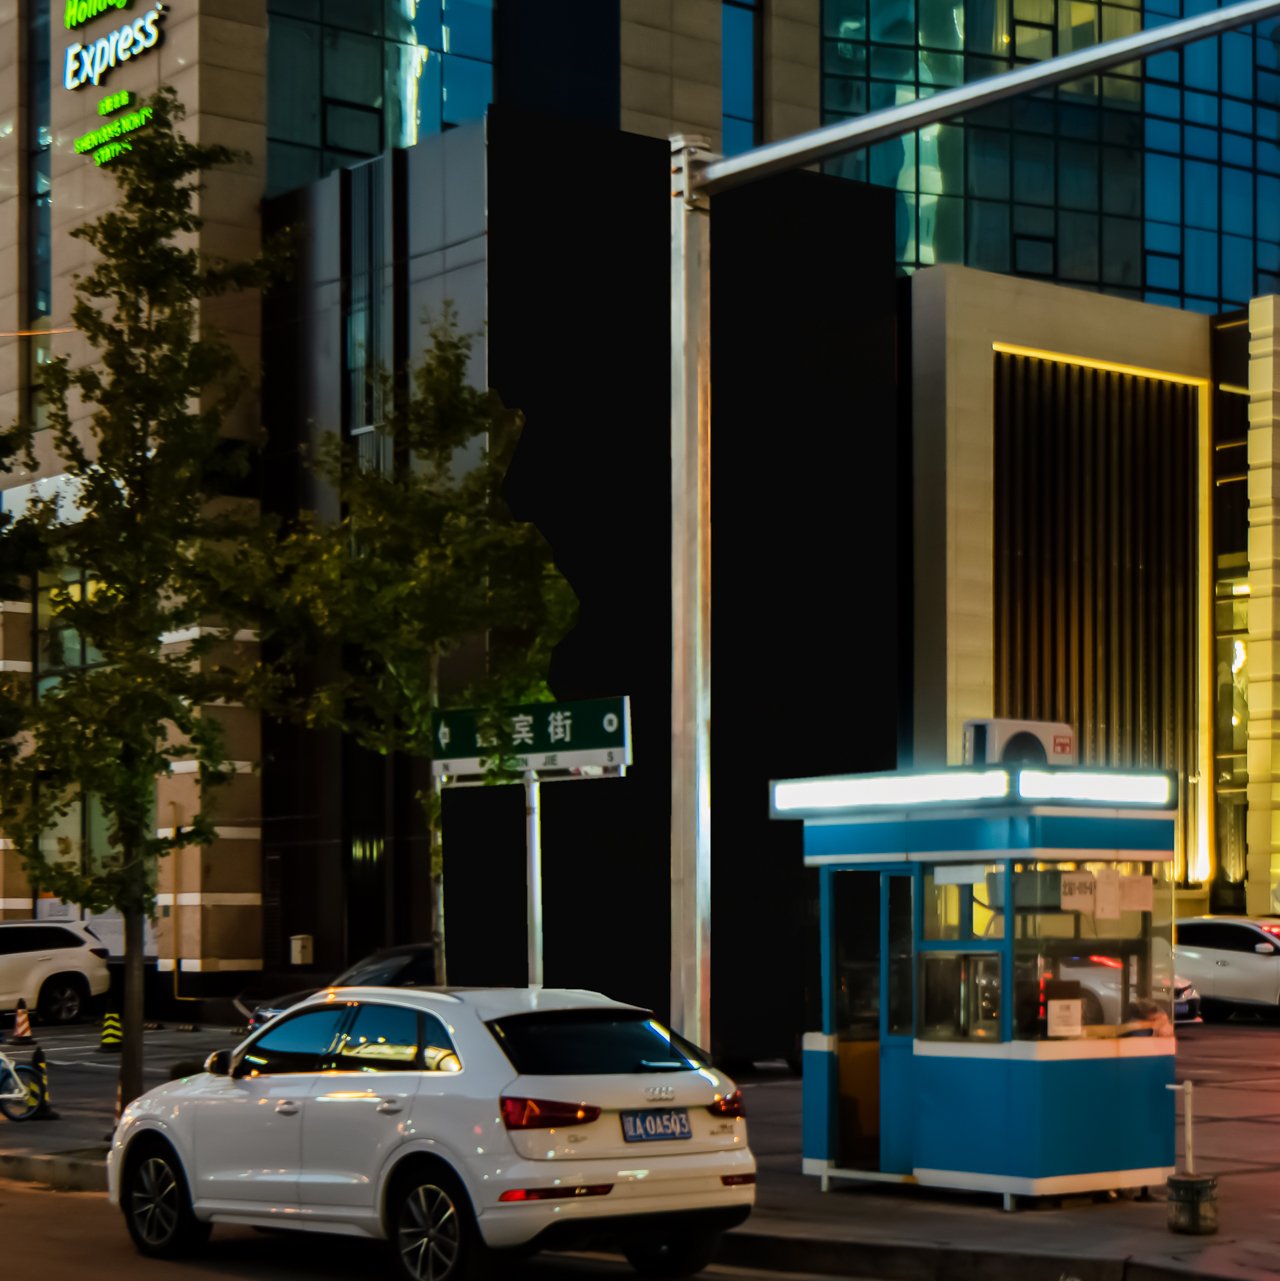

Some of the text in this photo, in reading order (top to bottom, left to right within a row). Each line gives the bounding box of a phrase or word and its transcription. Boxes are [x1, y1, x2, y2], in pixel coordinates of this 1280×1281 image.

[64, 7, 160, 90] Express
[476, 711, 572, 748] 宾街
[543, 754, 558, 767] JIE
[606, 752, 614, 762] S
[442, 763, 450, 772] N
